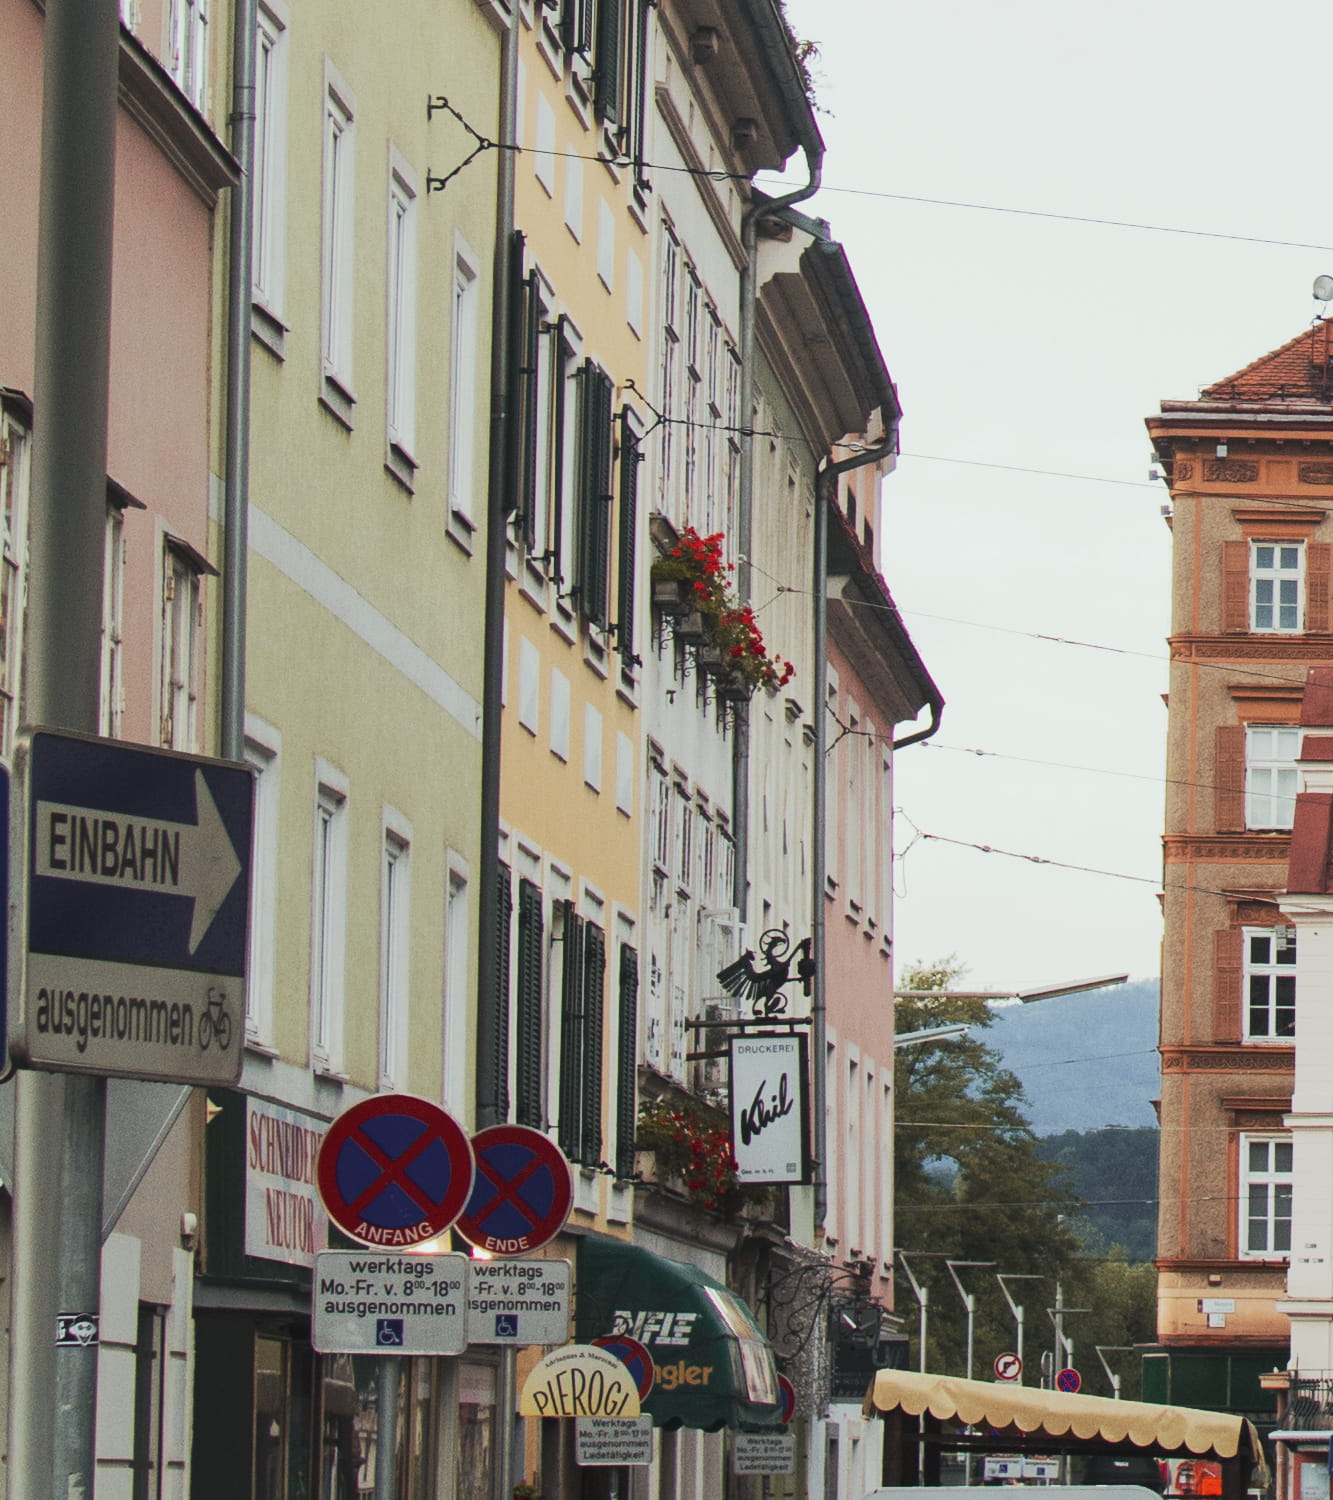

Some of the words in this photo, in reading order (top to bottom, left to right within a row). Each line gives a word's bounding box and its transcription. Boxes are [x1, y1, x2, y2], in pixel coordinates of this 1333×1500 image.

[50, 811, 180, 886] EINBAHN
[37, 987, 194, 1053] ausgenommen
[738, 1044, 794, 1055] DRUCKEREI
[265, 1187, 315, 1254] NEUTOR
[354, 1222, 434, 1245] ANFANG
[485, 1236, 529, 1251] ENDE
[350, 1258, 434, 1276] werktags
[474, 1264, 543, 1280] werktags
[320, 1279, 378, 1297] Mo.-Fr.
[384, 1284, 398, 1297] v.
[502, 1286, 513, 1295] v.
[324, 1300, 456, 1317] ausgenommen
[533, 1368, 629, 1416] PIEROGI
[592, 1420, 637, 1429] Werktags
[580, 1441, 649, 1449] ausgenommen
